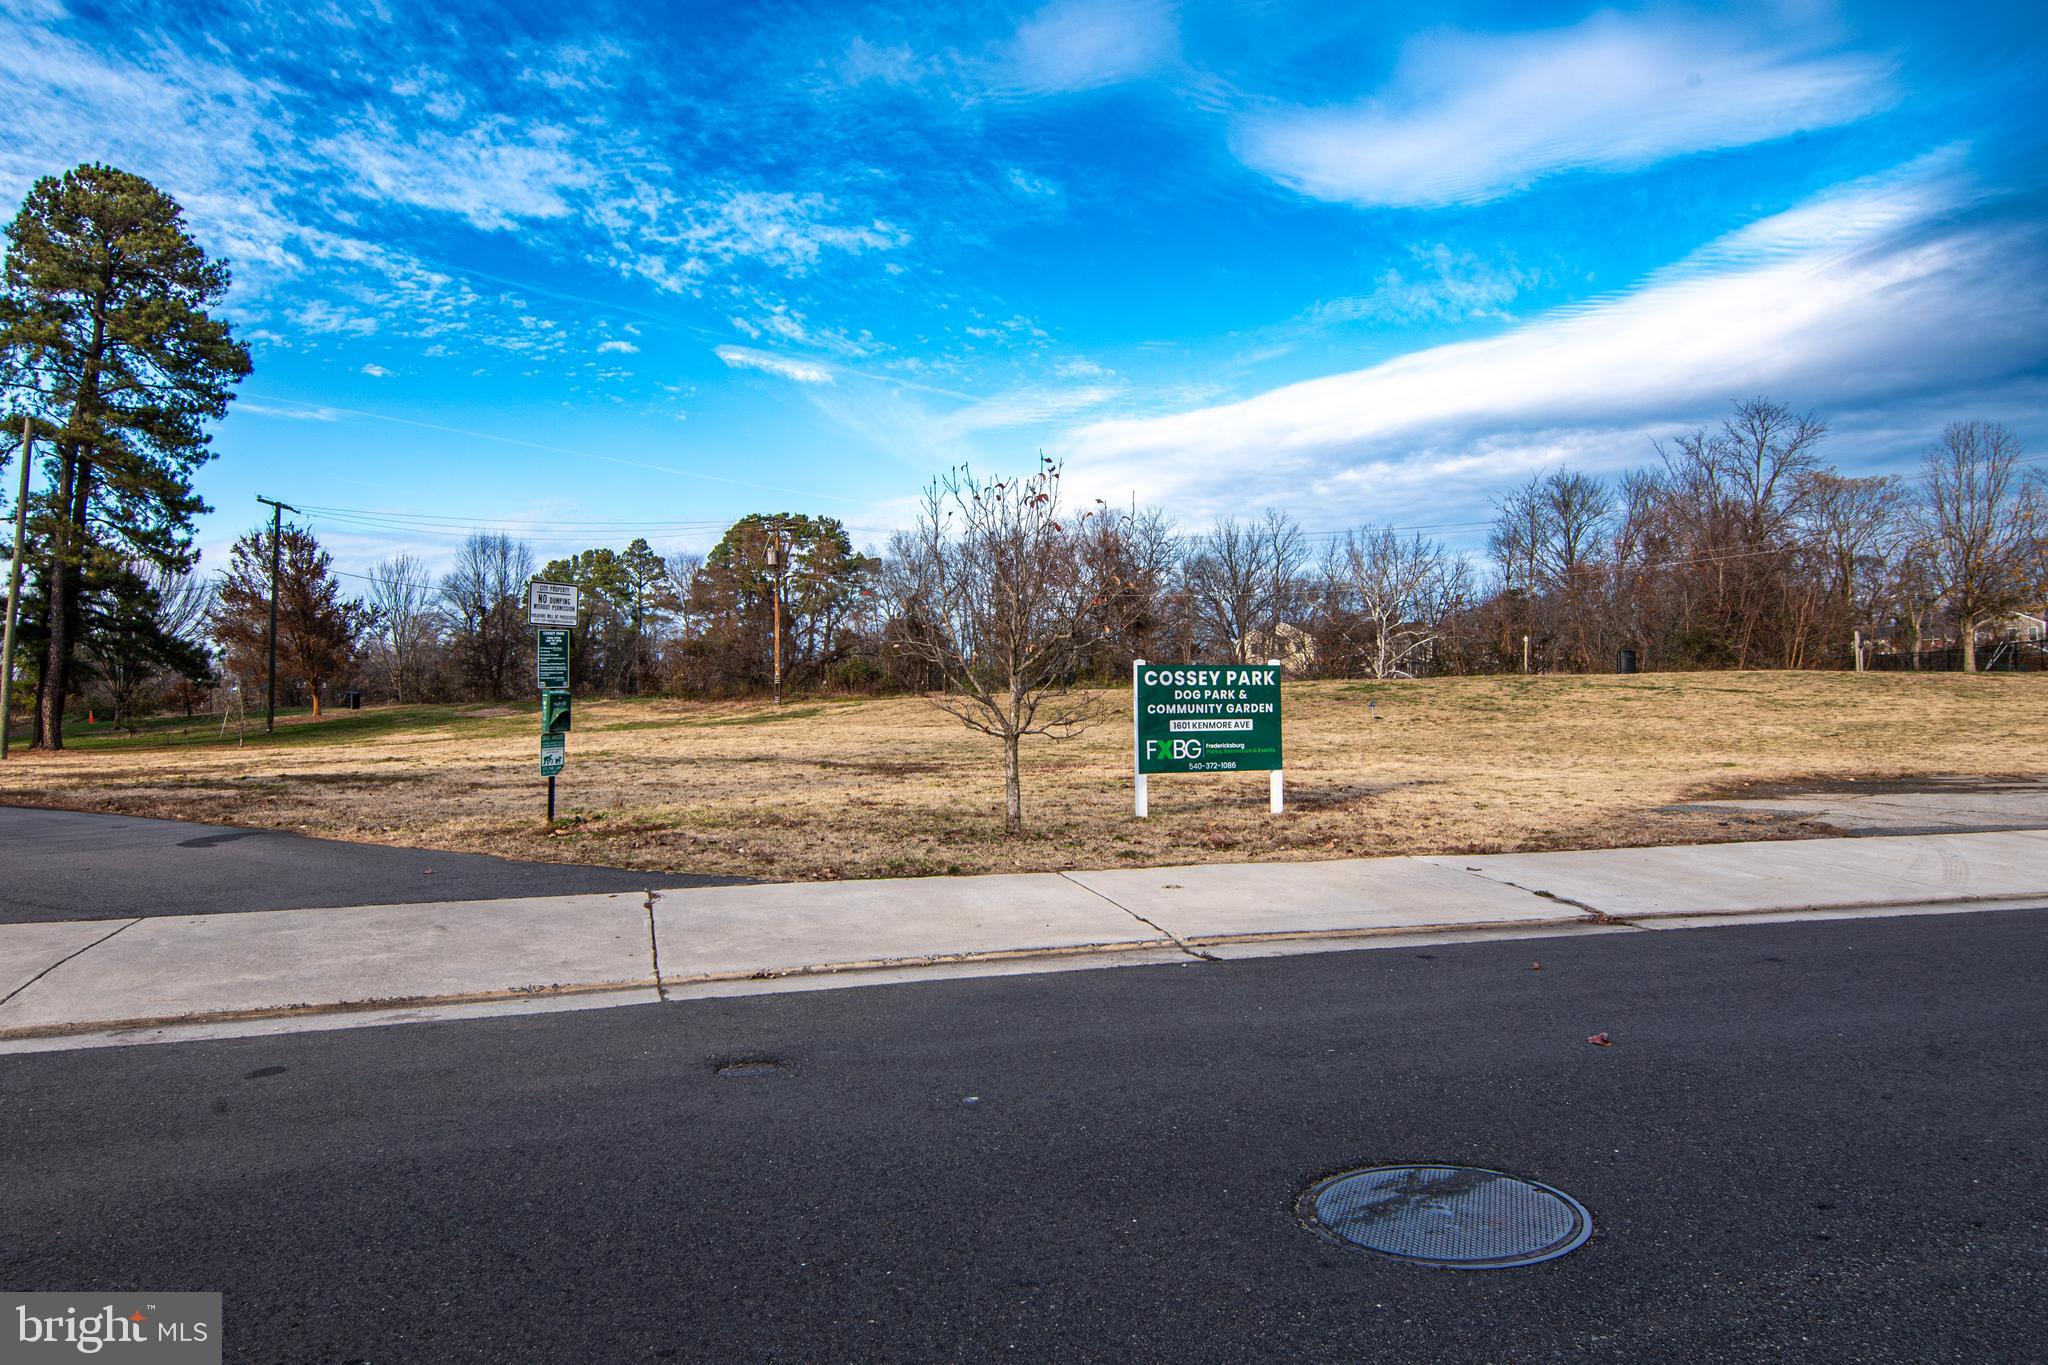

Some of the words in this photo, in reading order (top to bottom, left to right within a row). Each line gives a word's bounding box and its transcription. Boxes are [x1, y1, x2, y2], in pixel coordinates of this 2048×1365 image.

[538, 594, 547, 603] NO
[550, 597, 570, 605] DUMPING
[1144, 670, 1221, 686] COSSEY
[1227, 670, 1275, 686] PARK
[1174, 690, 1201, 700] DOG
[1205, 690, 1235, 700] PARK
[1239, 690, 1247, 699] &
[1148, 704, 1222, 714] COMMUNITY
[1226, 703, 1273, 713] GARDEN
[1147, 739, 1201, 760] FXBG
